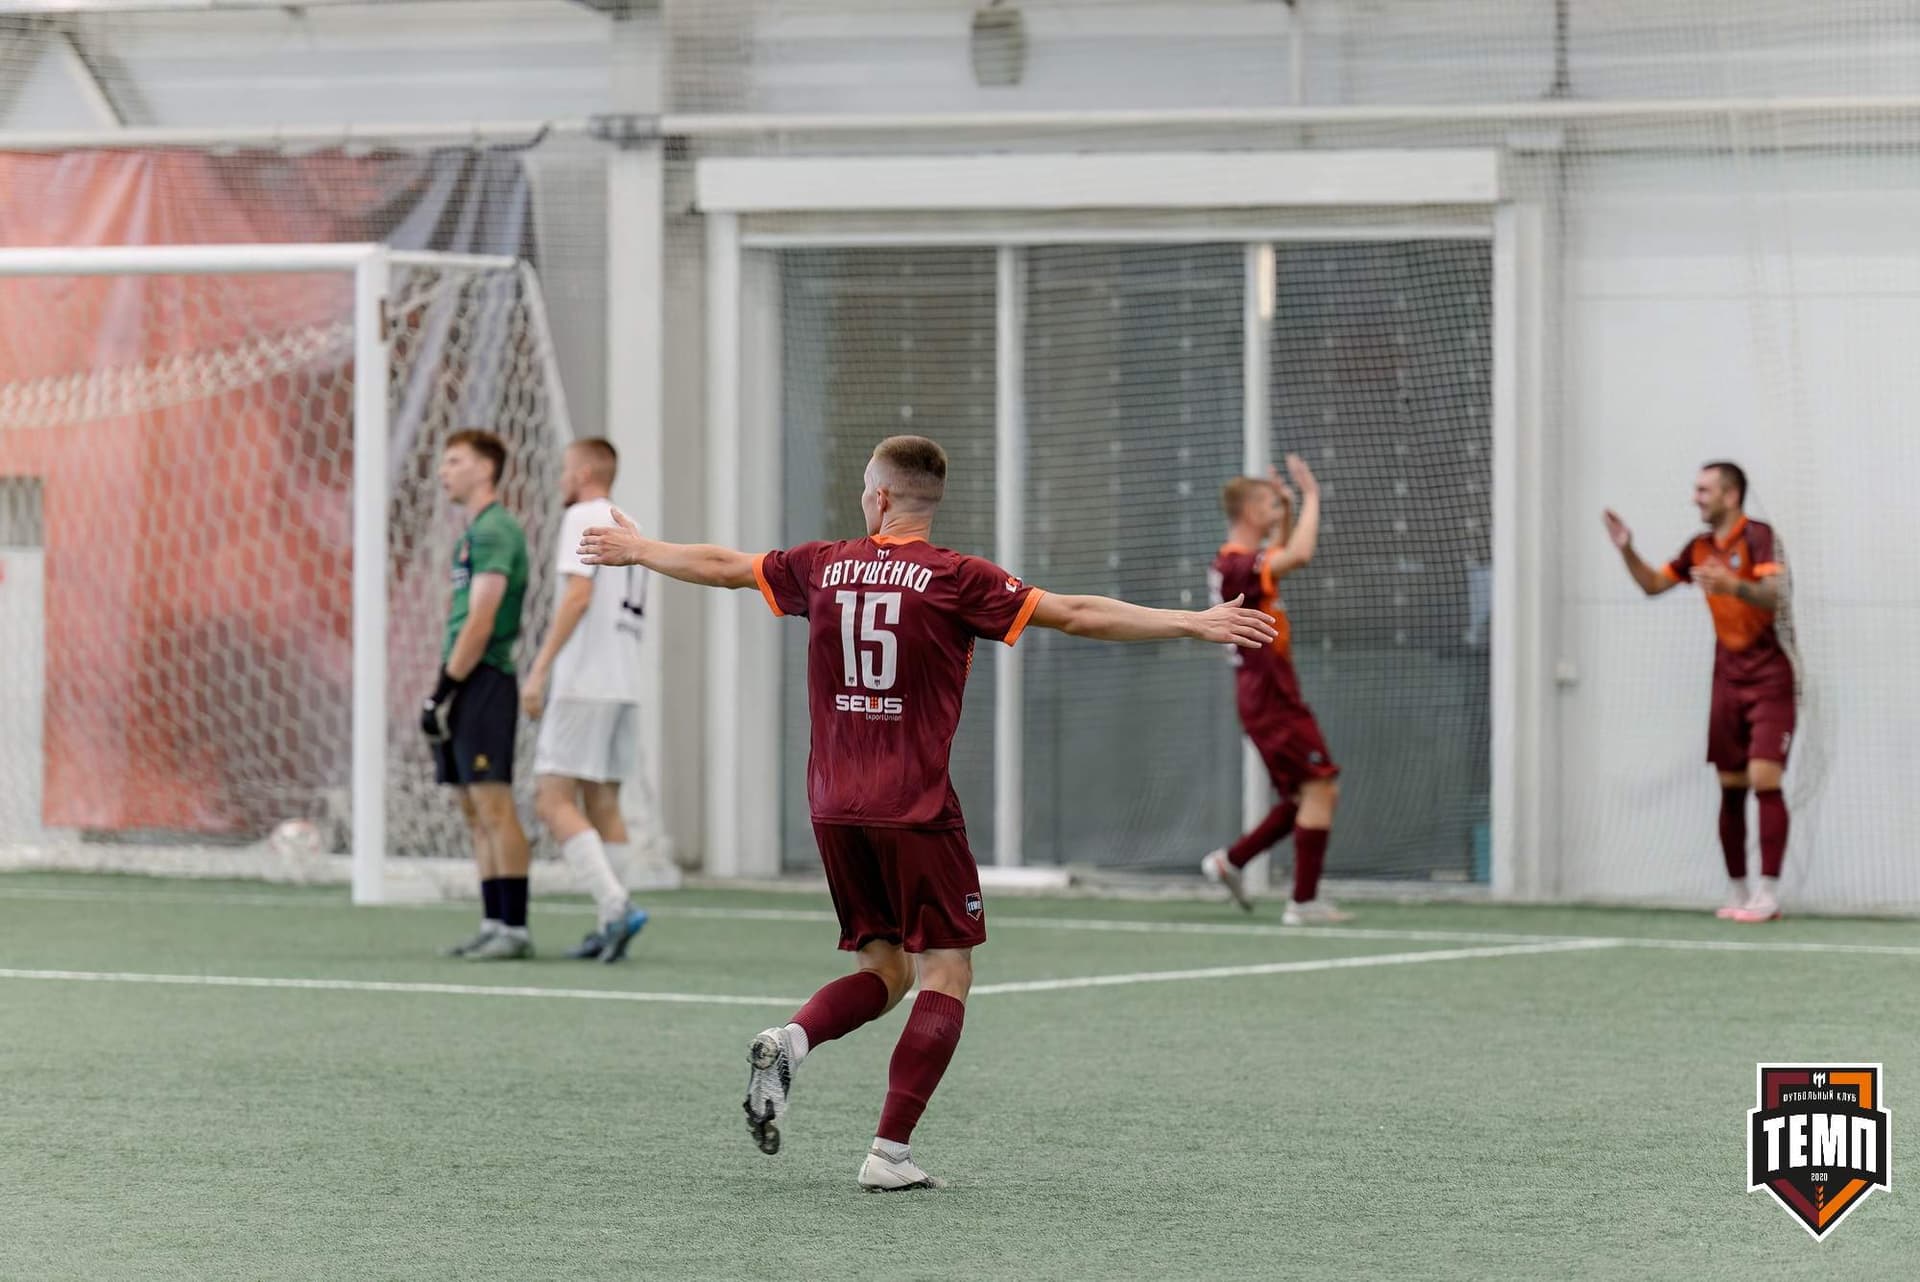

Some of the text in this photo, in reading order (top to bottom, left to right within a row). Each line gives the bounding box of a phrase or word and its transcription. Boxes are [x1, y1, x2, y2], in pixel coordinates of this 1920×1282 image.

[821, 559, 933, 593] ЕВТУШЕНКО
[835, 590, 902, 690] 15
[835, 694, 903, 714] SEUS
